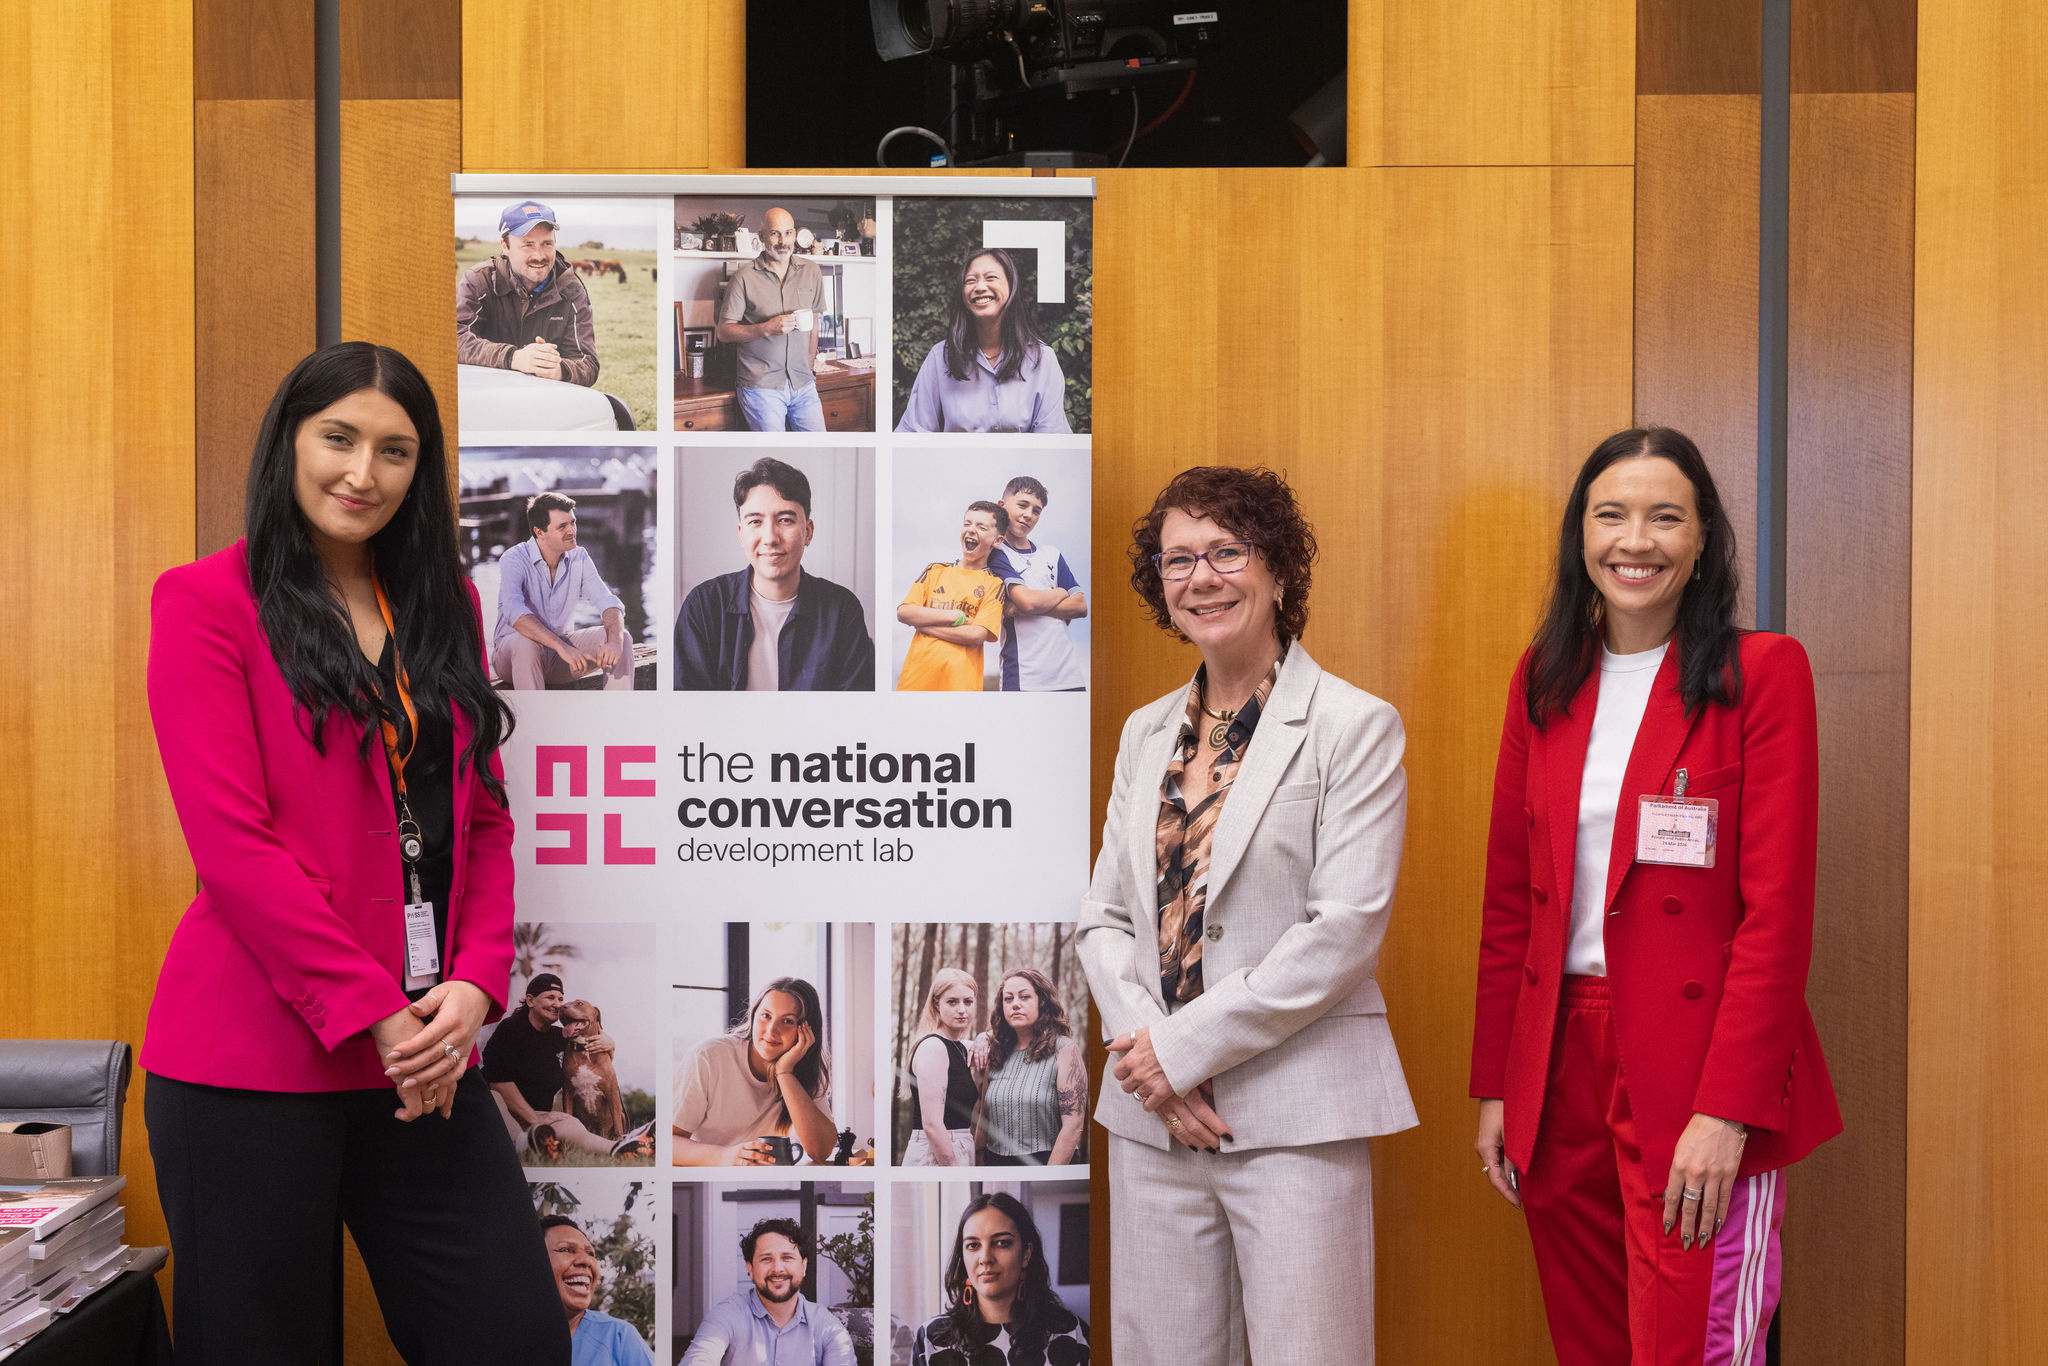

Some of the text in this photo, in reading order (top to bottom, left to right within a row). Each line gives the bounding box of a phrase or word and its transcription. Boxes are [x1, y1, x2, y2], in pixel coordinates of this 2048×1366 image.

[678, 742, 975, 783] the national
[678, 788, 1012, 828] conversation
[678, 837, 914, 867] development lab
